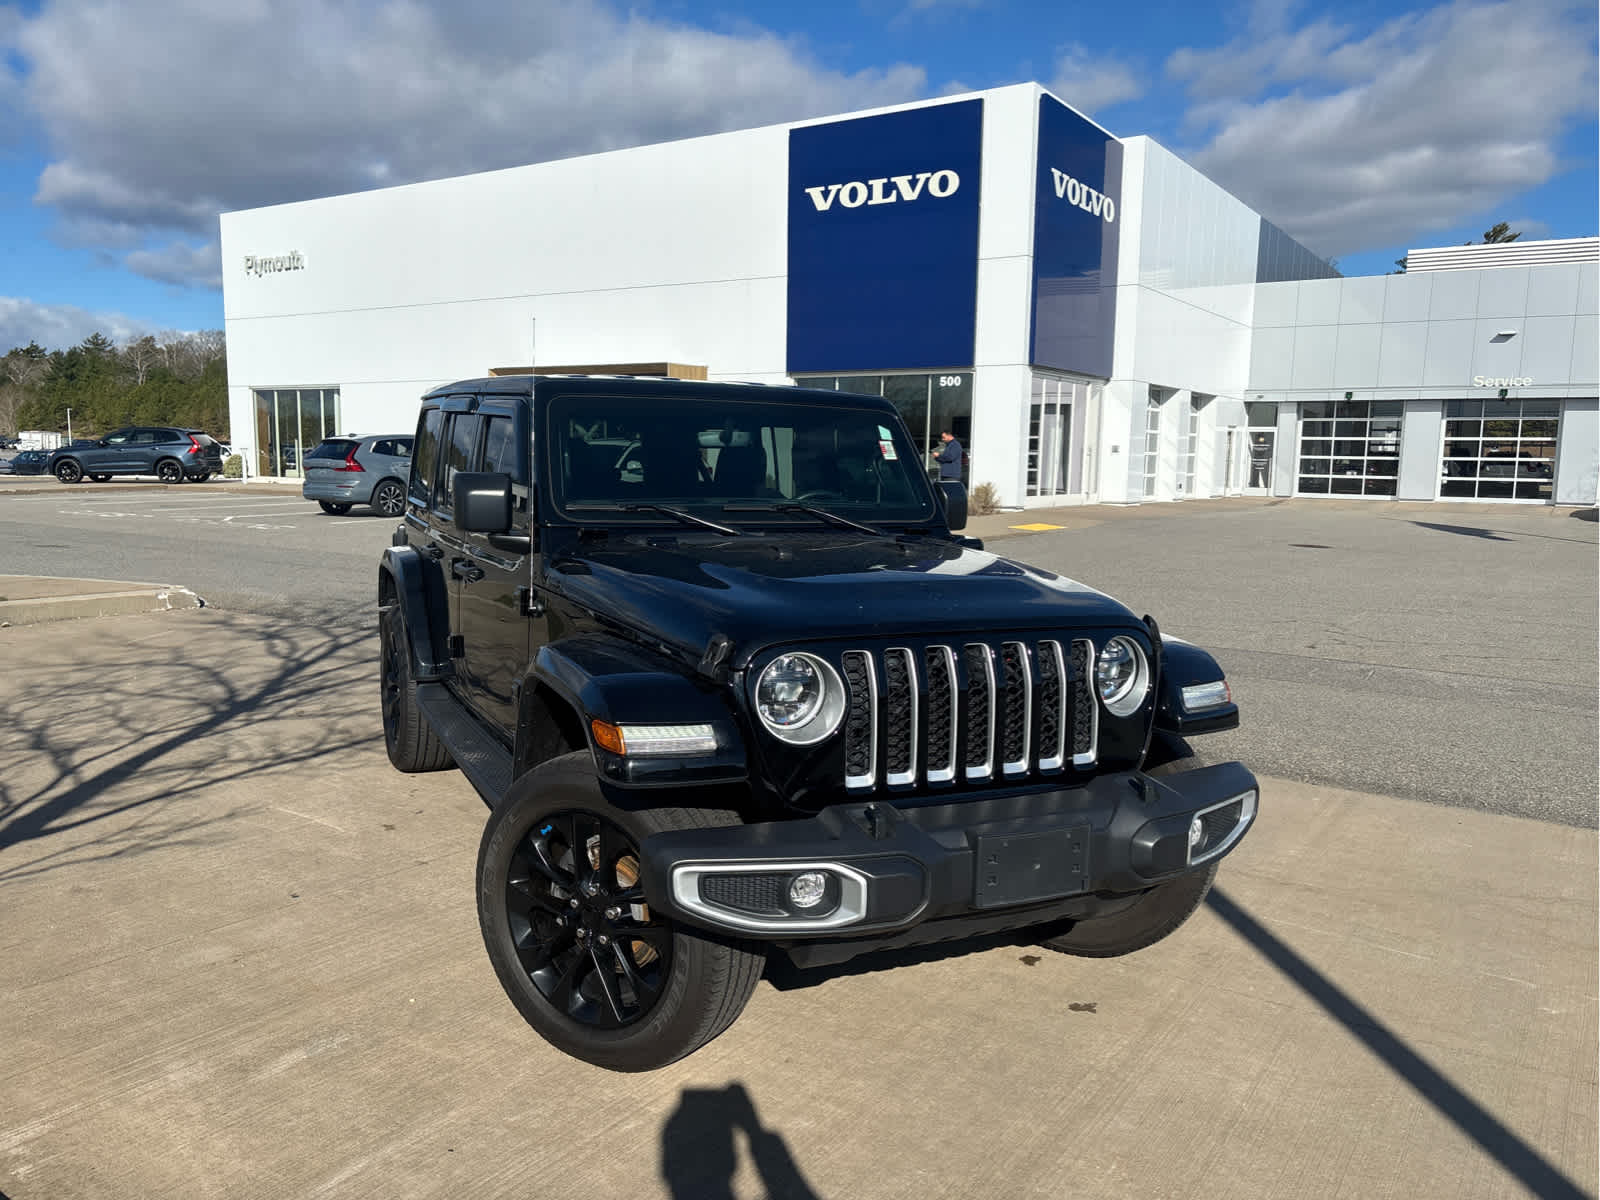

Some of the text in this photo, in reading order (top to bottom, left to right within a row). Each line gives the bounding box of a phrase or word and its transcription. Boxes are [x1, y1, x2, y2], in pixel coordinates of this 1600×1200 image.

[805, 169, 960, 212] VOLVO
[1051, 167, 1115, 223] VOLVO
[243, 249, 305, 278] Plymouth
[940, 376, 961, 387] 500
[1472, 374, 1533, 387] Service
